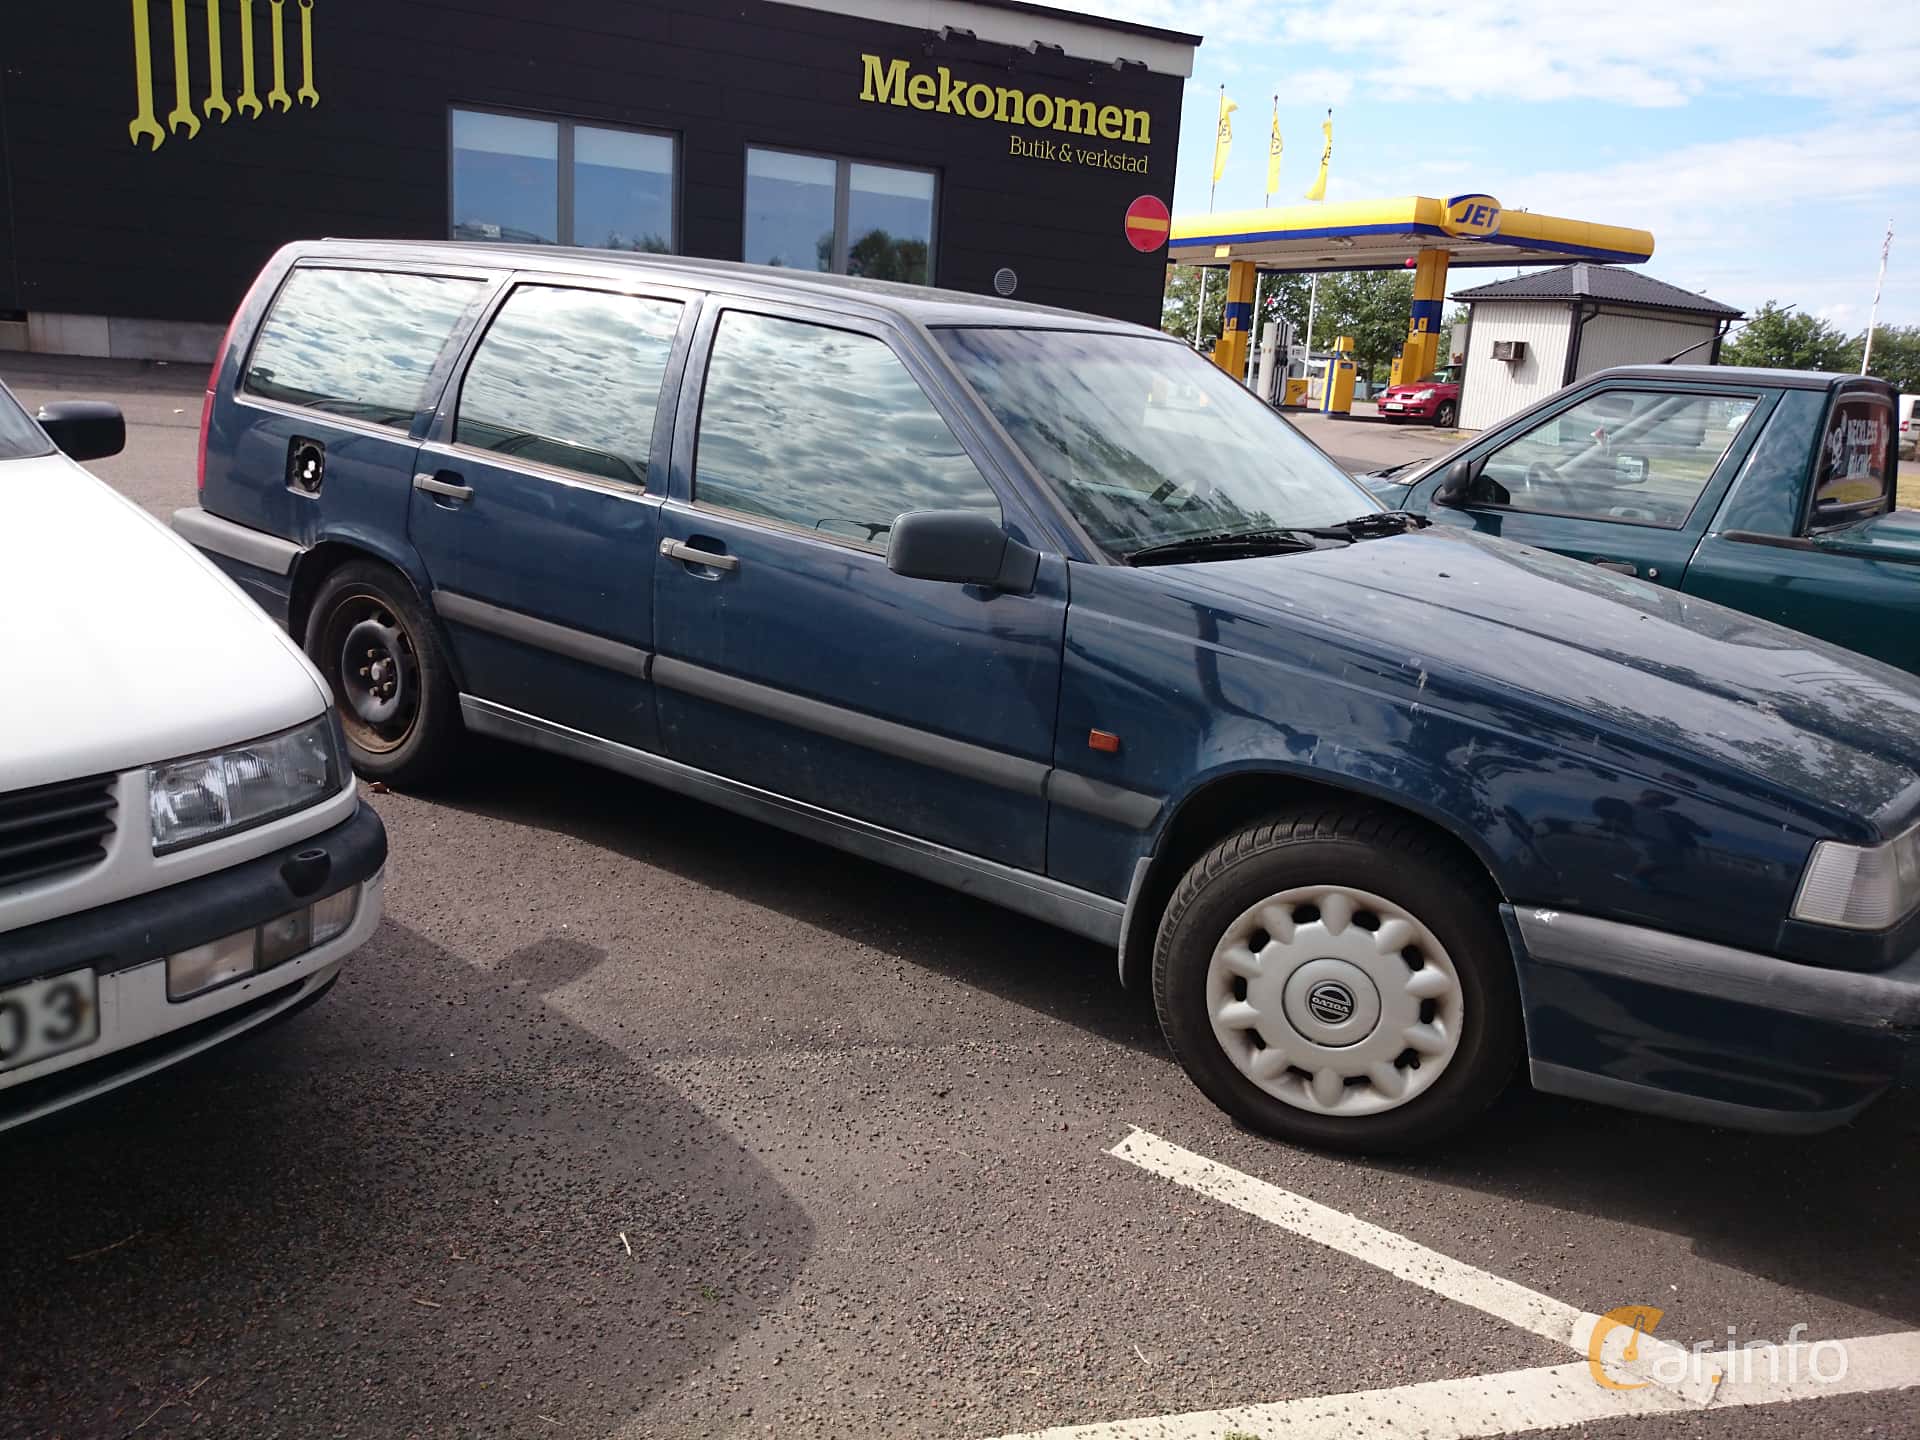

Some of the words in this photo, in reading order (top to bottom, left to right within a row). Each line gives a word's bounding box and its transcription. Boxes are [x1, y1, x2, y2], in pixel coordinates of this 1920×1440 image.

[859, 53, 1151, 144] Mekonomen
[1009, 135, 1055, 161] Butik
[1059, 143, 1072, 163] &
[1076, 148, 1149, 174] verkstad
[1456, 204, 1499, 228] JET
[1312, 997, 1349, 1013] VOLVO
